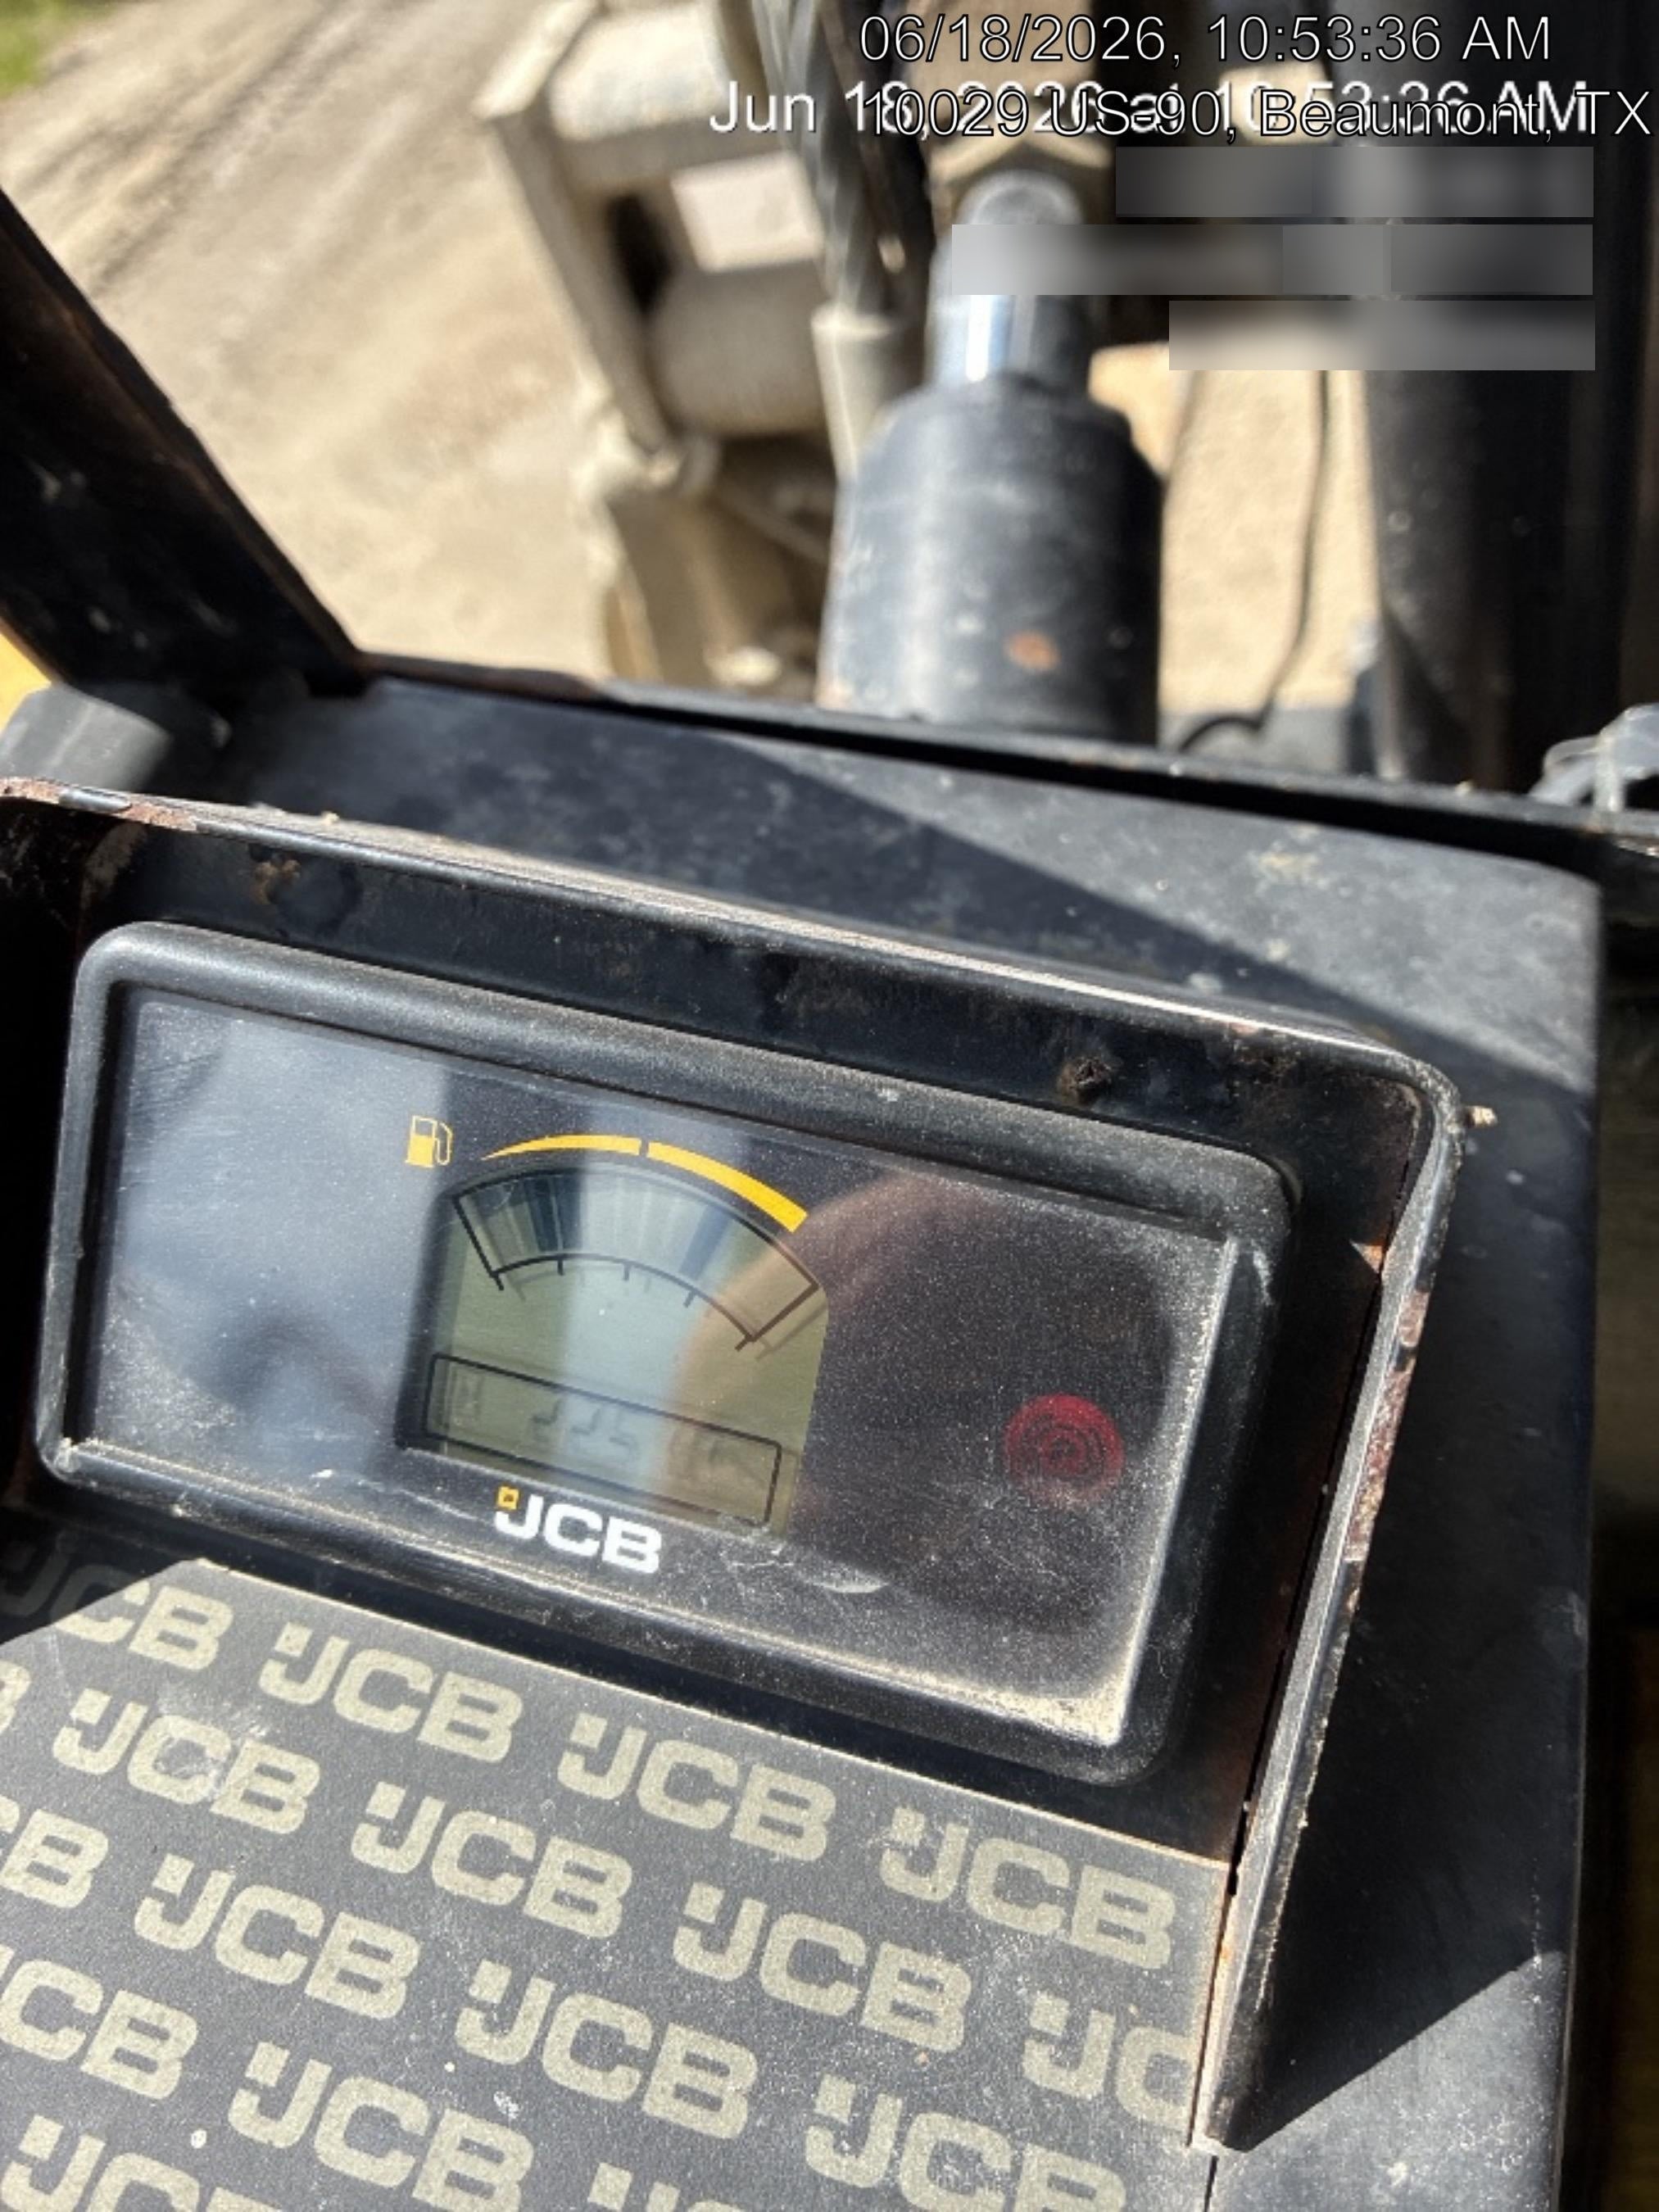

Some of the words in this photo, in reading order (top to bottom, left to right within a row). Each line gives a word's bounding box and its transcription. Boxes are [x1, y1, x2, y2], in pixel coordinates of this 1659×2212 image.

[493, 1484, 663, 1575] JCB
[52, 1688, 320, 1835] JCB
[260, 1622, 524, 1764] JCB
[351, 1781, 633, 1939] JCB
[558, 1714, 836, 1862] JCB
[134, 1855, 422, 2021] JCB
[879, 1806, 1176, 1970] JCB
[673, 1883, 972, 2052] JCB
[227, 2041, 535, 2212] JCB
[454, 1958, 759, 2140] JCB
[805, 2074, 1127, 2212] JCB
